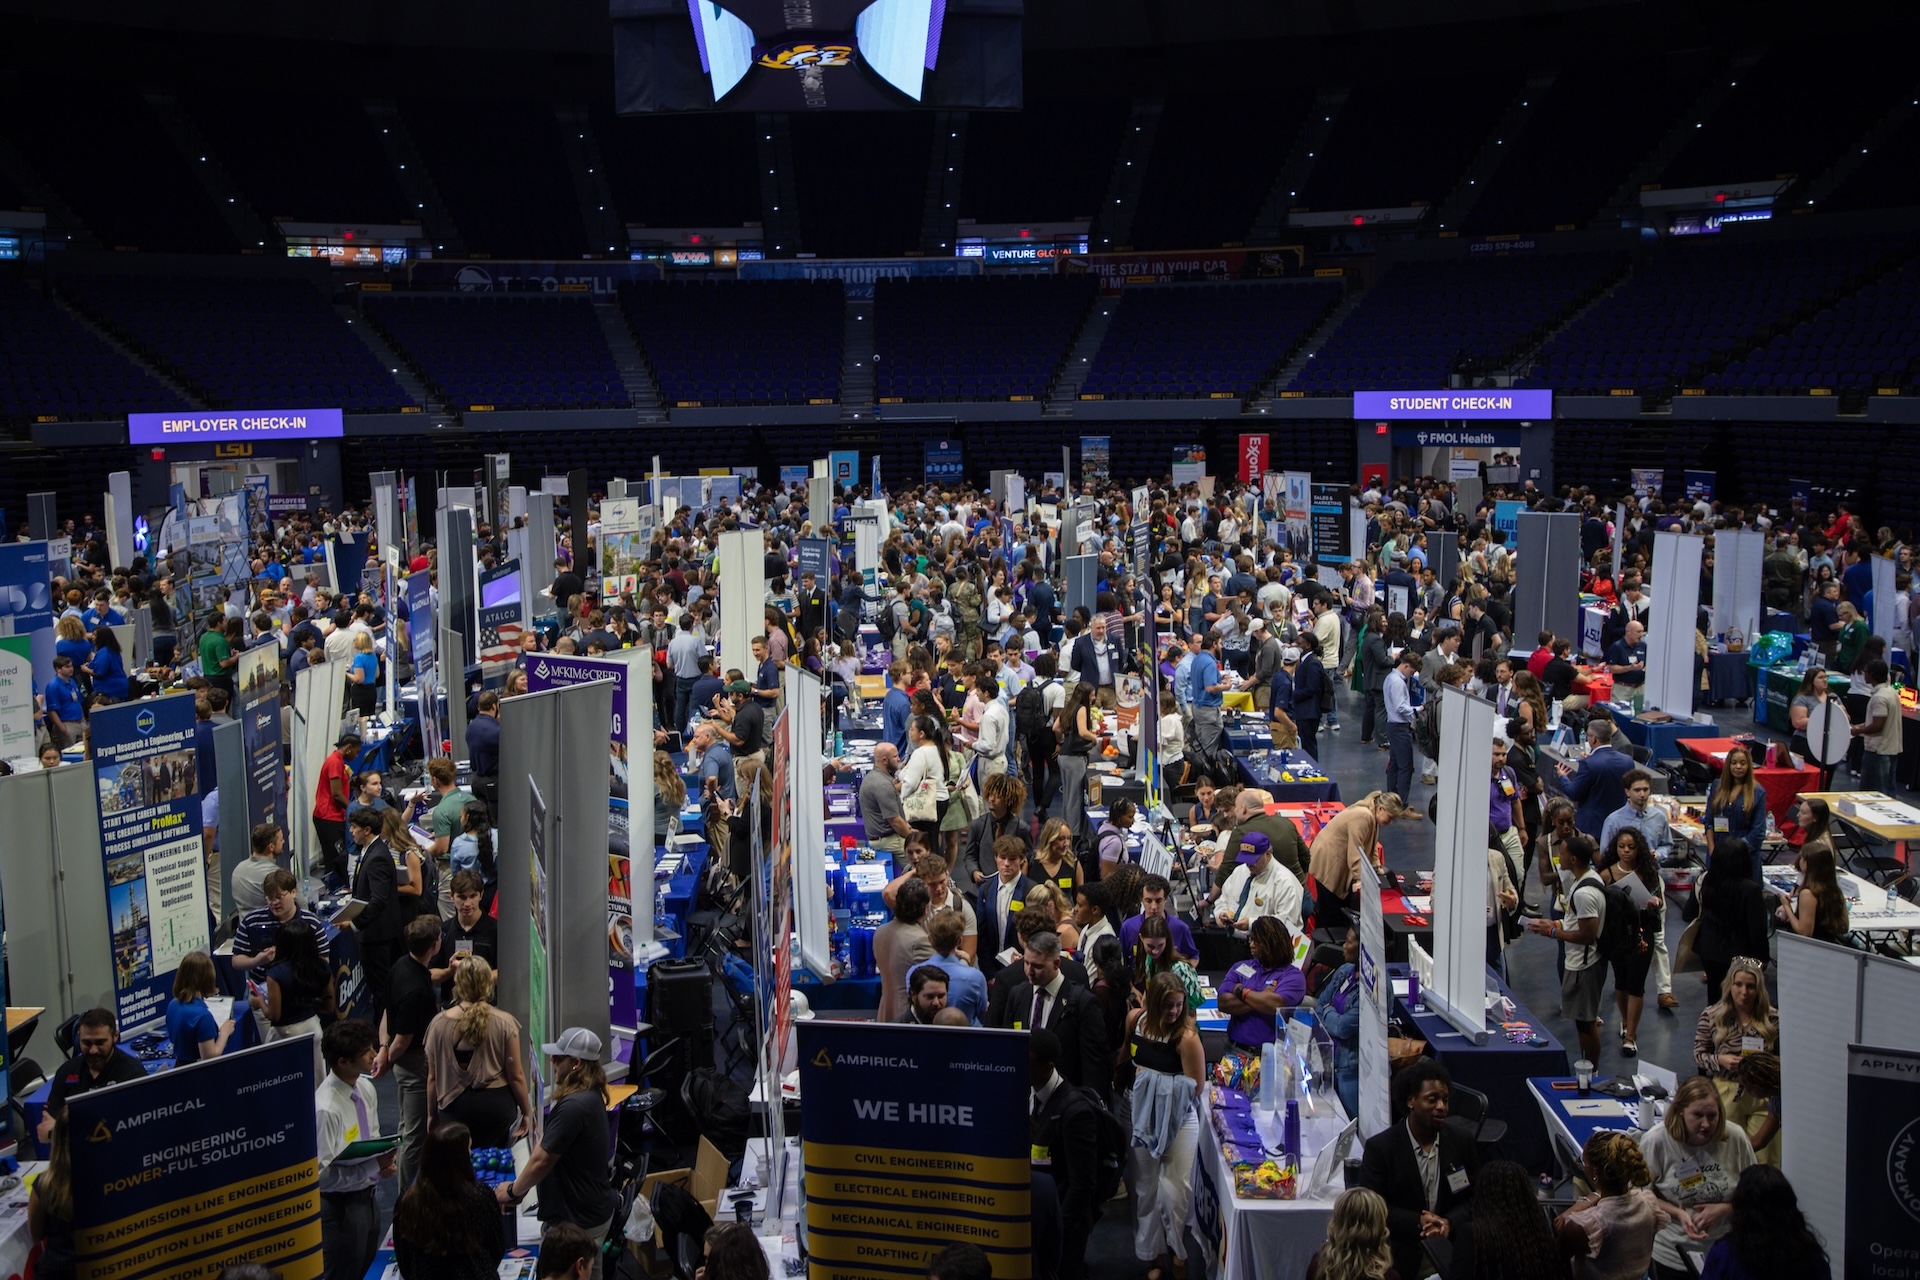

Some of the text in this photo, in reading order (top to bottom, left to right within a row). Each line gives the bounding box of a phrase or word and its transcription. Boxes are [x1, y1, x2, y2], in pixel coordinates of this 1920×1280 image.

[992, 249, 1036, 259] VENTURE
[1471, 240, 1535, 252] (225) 578-4085
[1094, 263, 1116, 276] THE
[1120, 262, 1148, 276] STAY
[1152, 261, 1164, 274] IN
[1203, 260, 1228, 272] CAR
[498, 276, 559, 292] TO
[1389, 397, 1512, 410] STUDENT CHECK-IN
[162, 416, 307, 433] EMPLOYER CHECK-IN
[1430, 432, 1495, 444] FMOL Health
[215, 443, 253, 457] LSU
[1497, 519, 1514, 530] LEAD
[485, 610, 515, 623] ATALCO
[1585, 627, 1600, 643] LSU
[97, 728, 195, 758] Bryan Research & Engineering, LLC
[103, 803, 172, 829] START YOUR CAREER WITH
[104, 831, 117, 842] THE
[117, 823, 143, 838] CREATORS
[143, 821, 151, 832] OF
[105, 824, 191, 856] PROCESS SIMULATION SOFTWARE
[148, 841, 200, 863] ENGINEERING ROLES:
[152, 856, 198, 876] Technical Support
[156, 869, 195, 887] Technical Sales
[160, 881, 194, 897] Development
[161, 892, 194, 909] Applications
[609, 895, 631, 904] LUMBING
[609, 960, 624, 969] UILD
[120, 986, 152, 1006] Apply Today!
[835, 1054, 918, 1069] AMPIRICAL
[949, 1061, 1016, 1074] ampirical.com
[236, 1070, 304, 1096] ampirical.com
[115, 1097, 207, 1133] AMPIRICAL
[853, 1099, 975, 1127] WE HIRE
[142, 1126, 248, 1168] ENGINEERING
[103, 1157, 199, 1196] POWER-FUL
[201, 1131, 287, 1166] SOLUTIONS
[855, 1153, 975, 1172] CIVIL ENGINEERING
[834, 1183, 996, 1207] ELECTRICAL ENGINEERING
[86, 1167, 314, 1247] TRANSMISSION LINE ENGINEERING
[832, 1213, 1000, 1239] MECHANICAL ENGINEERING
[91, 1199, 313, 1279] DISTRIBUTION LINE ENGINEERING
[162, 1237, 297, 1280] ATION ENGINEERING
[857, 1246, 919, 1260] DRAFTING
[1870, 1242, 1920, 1260] Opera
[1873, 1263, 1909, 1278] local
